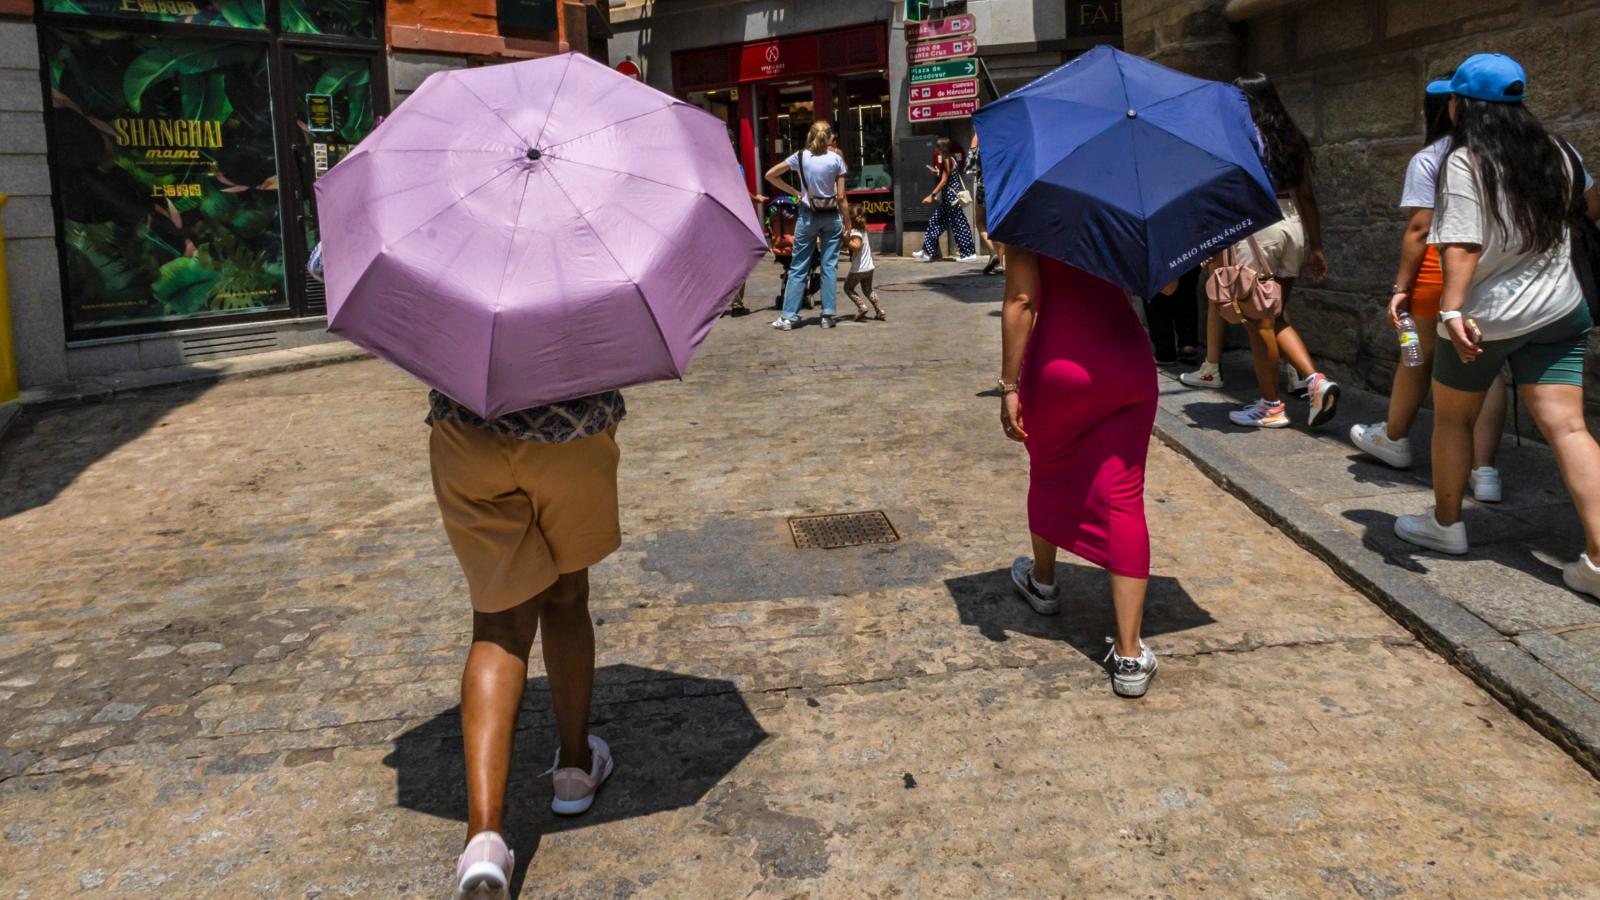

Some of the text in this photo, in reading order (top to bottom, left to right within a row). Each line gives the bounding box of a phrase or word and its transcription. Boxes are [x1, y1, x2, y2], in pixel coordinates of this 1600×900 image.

[931, 49, 947, 57] Cruz
[114, 118, 223, 147] SHANGHAI
[145, 149, 200, 158] mama
[1168, 218, 1253, 269] MARIO HERNÁNDEZ
